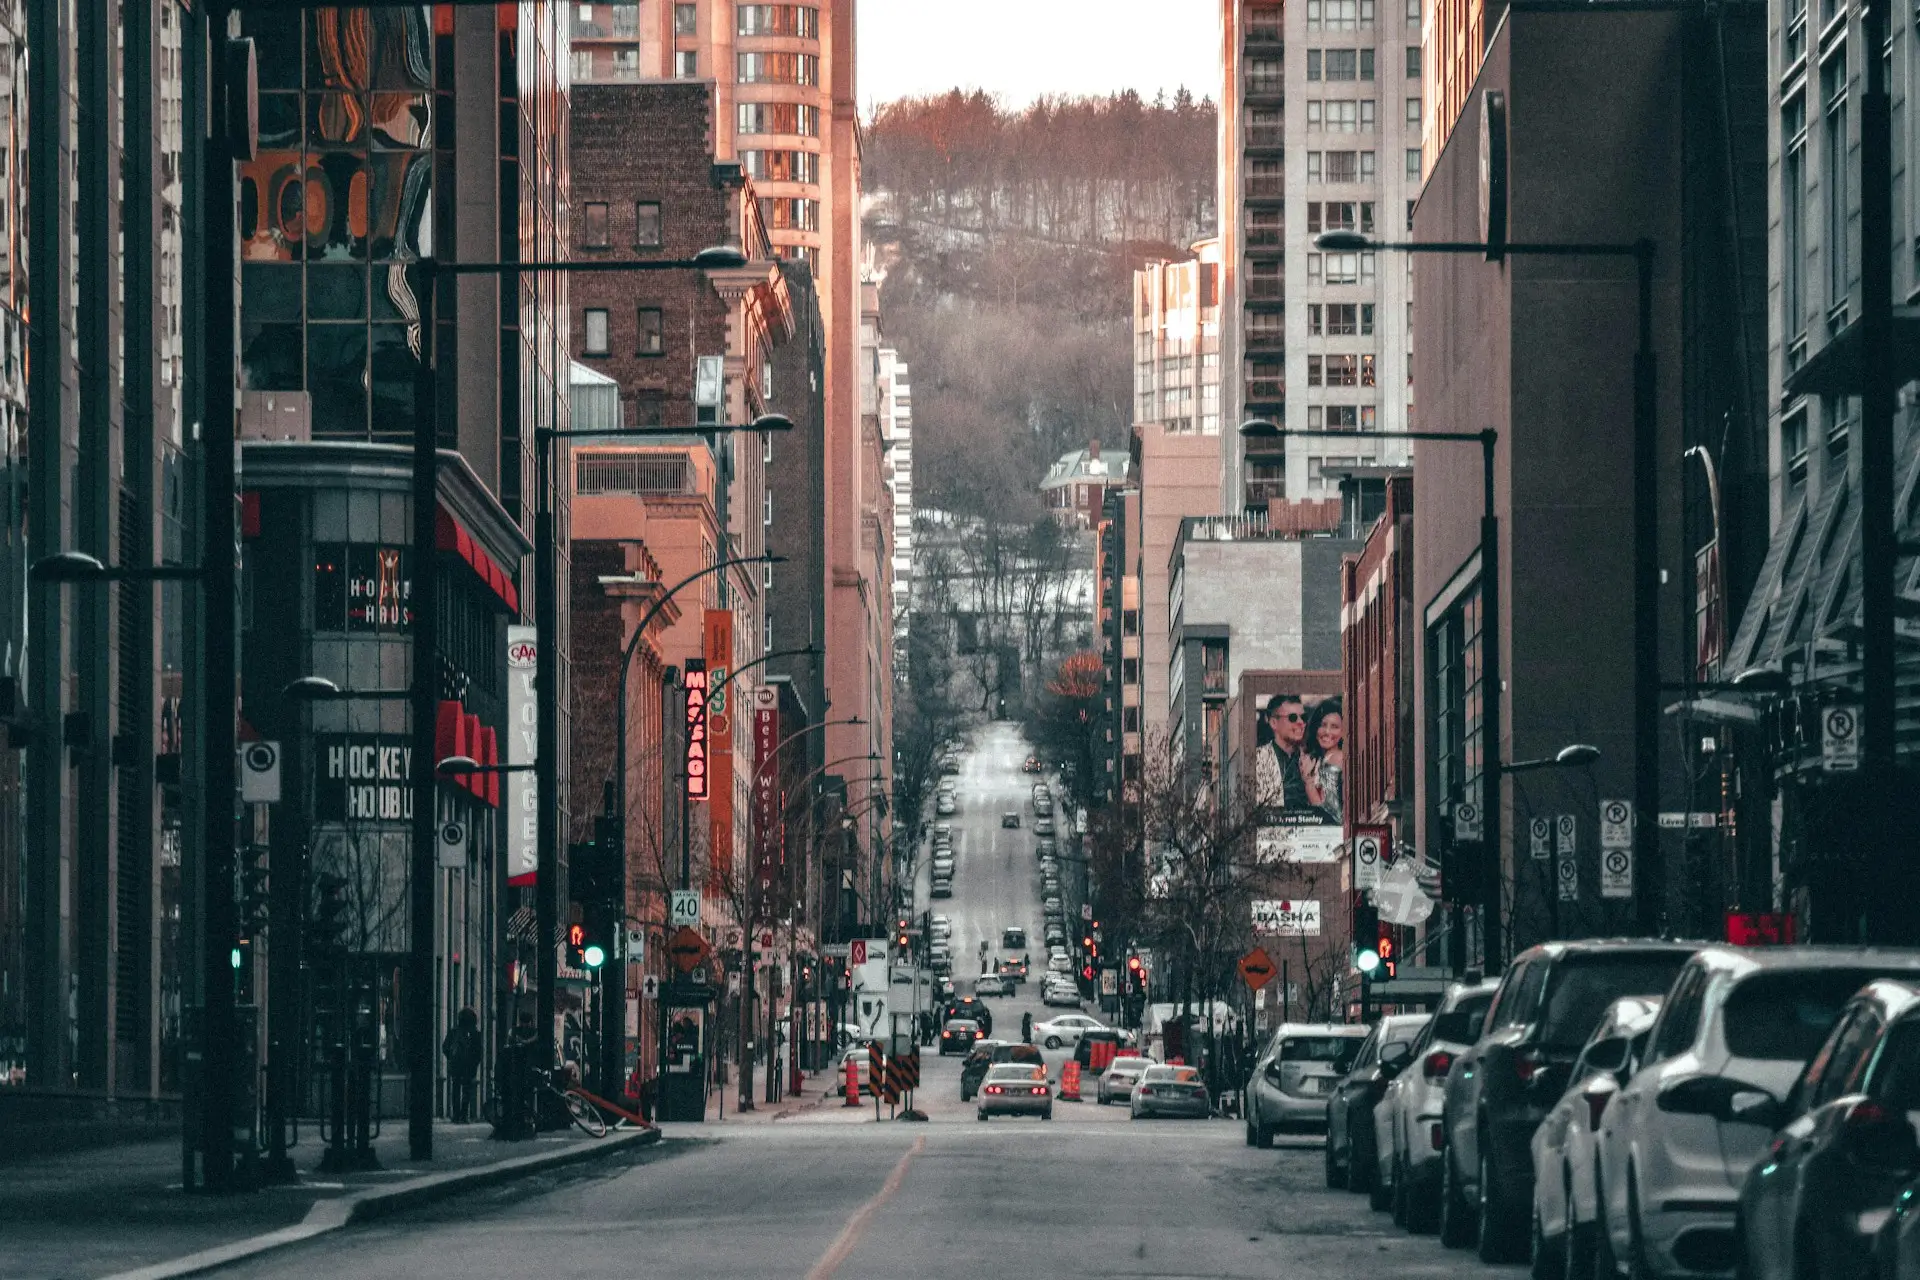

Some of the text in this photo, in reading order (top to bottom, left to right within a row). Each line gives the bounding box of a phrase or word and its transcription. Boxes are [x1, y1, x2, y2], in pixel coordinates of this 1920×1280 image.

[511, 643, 537, 662] CAA
[685, 671, 705, 794] MASSAGE
[761, 710, 771, 762] Best
[328, 745, 412, 780] HOCKEY
[1298, 814, 1324, 825] Stanley
[674, 898, 698, 917] 40
[1385, 961, 1395, 977] 7
